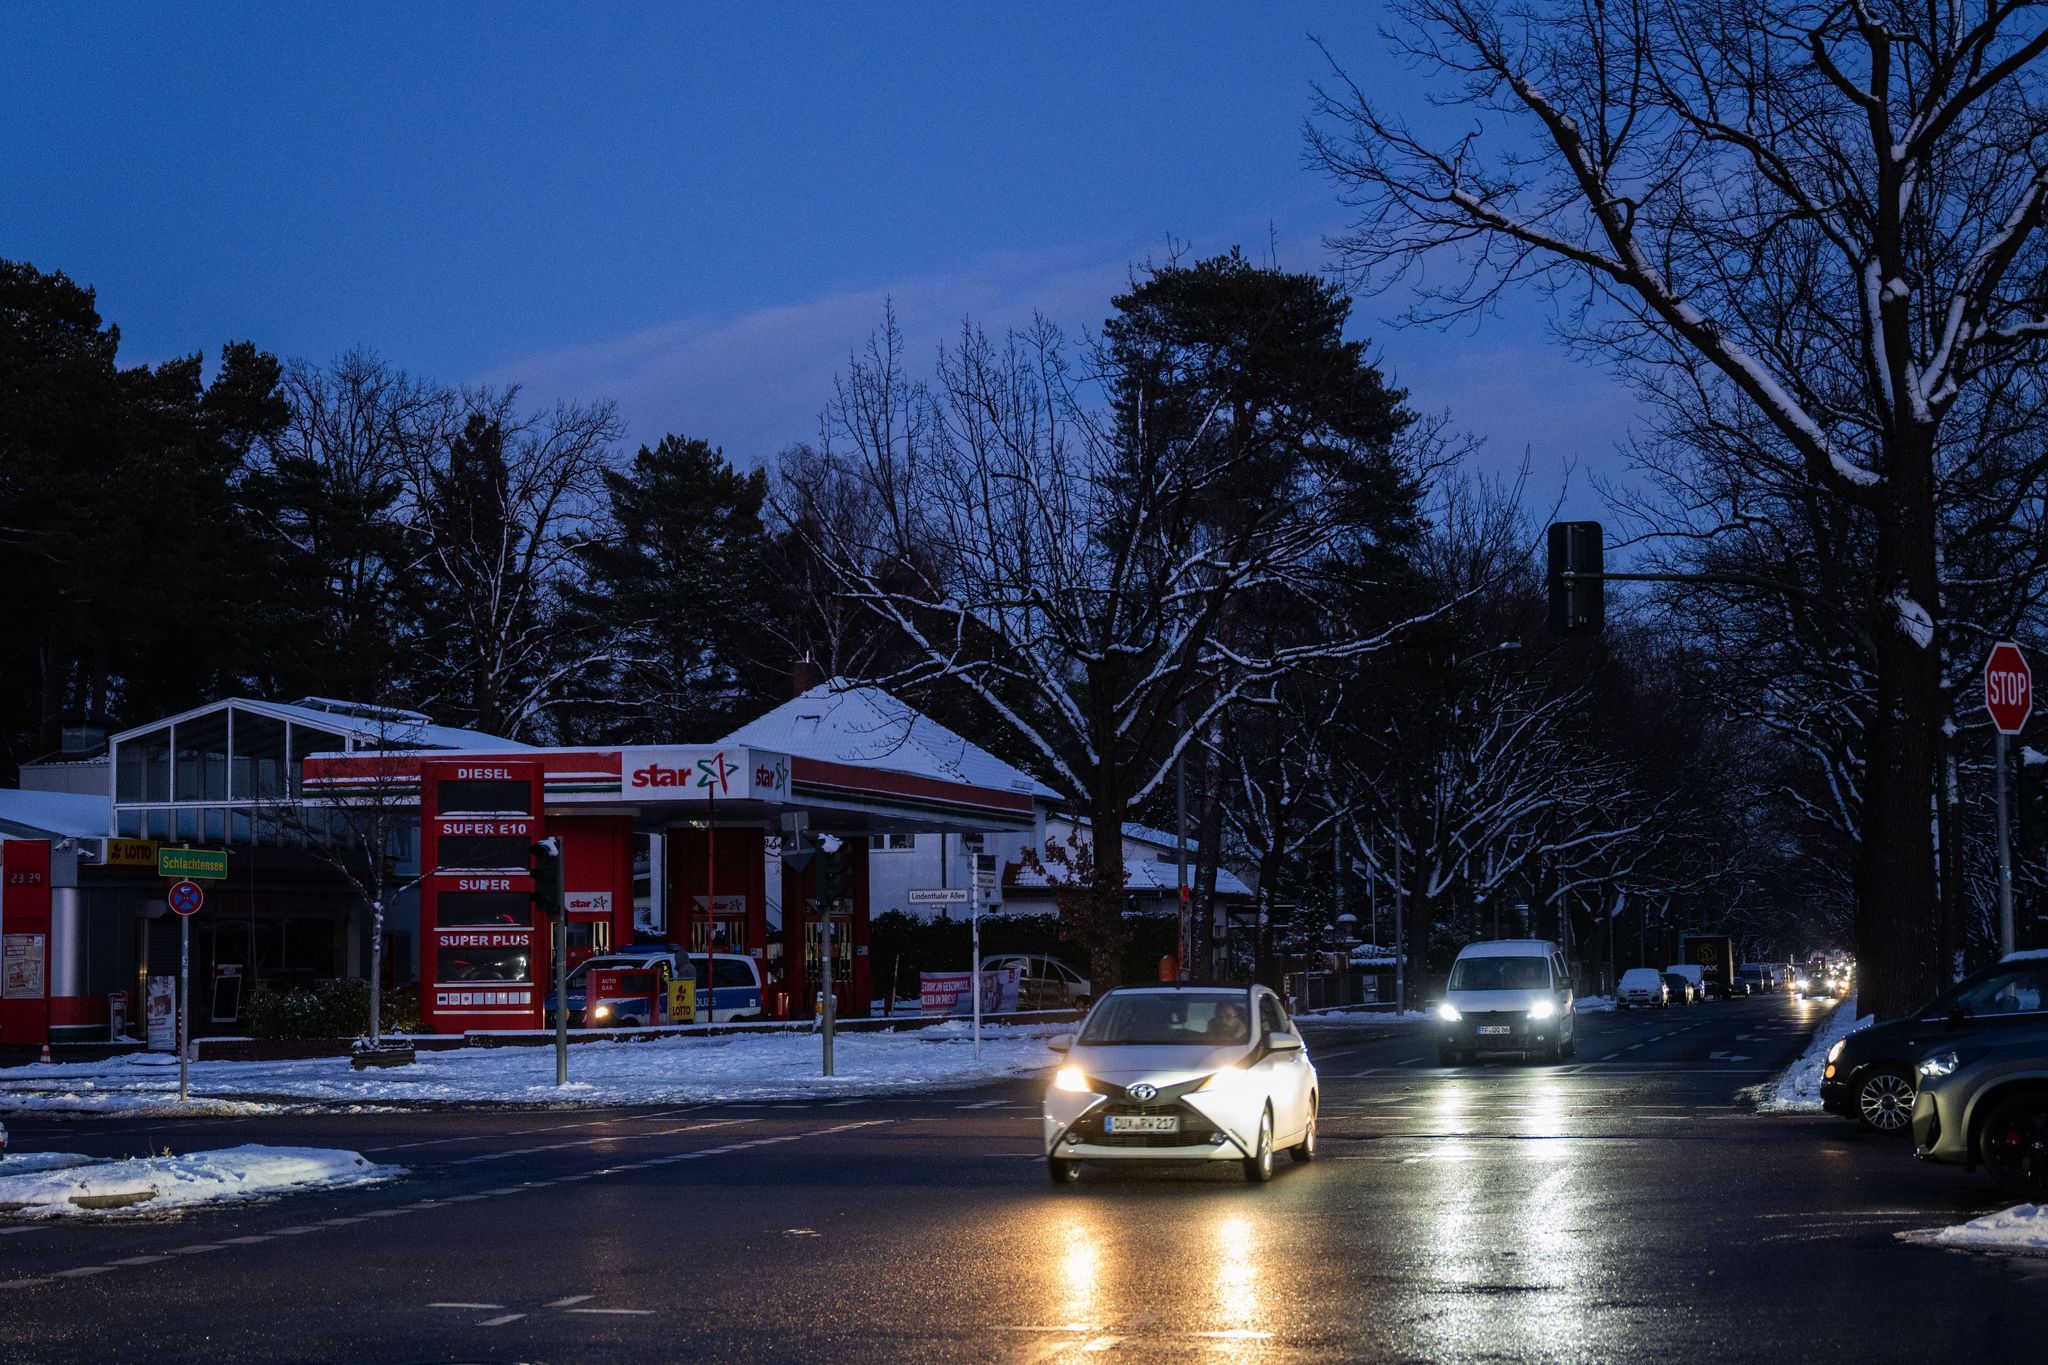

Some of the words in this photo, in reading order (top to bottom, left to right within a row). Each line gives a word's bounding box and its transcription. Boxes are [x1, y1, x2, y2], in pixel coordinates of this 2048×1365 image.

[1990, 670, 2027, 706] STOP
[457, 768, 512, 779] DIESEL
[631, 763, 692, 787] star
[755, 764, 774, 788] star
[442, 823, 495, 835] SUPER
[499, 823, 528, 835] E10
[125, 845, 152, 860] LOTTO
[162, 855, 225, 872] Schlachtensee
[458, 879, 511, 891] SUPER
[911, 892, 948, 900] Lindenthaler
[569, 899, 592, 908] star
[439, 935, 489, 947] SUPER
[492, 934, 530, 947] PLUS
[672, 1005, 691, 1017] LOTTO
[1155, 1118, 1176, 1130] 217
